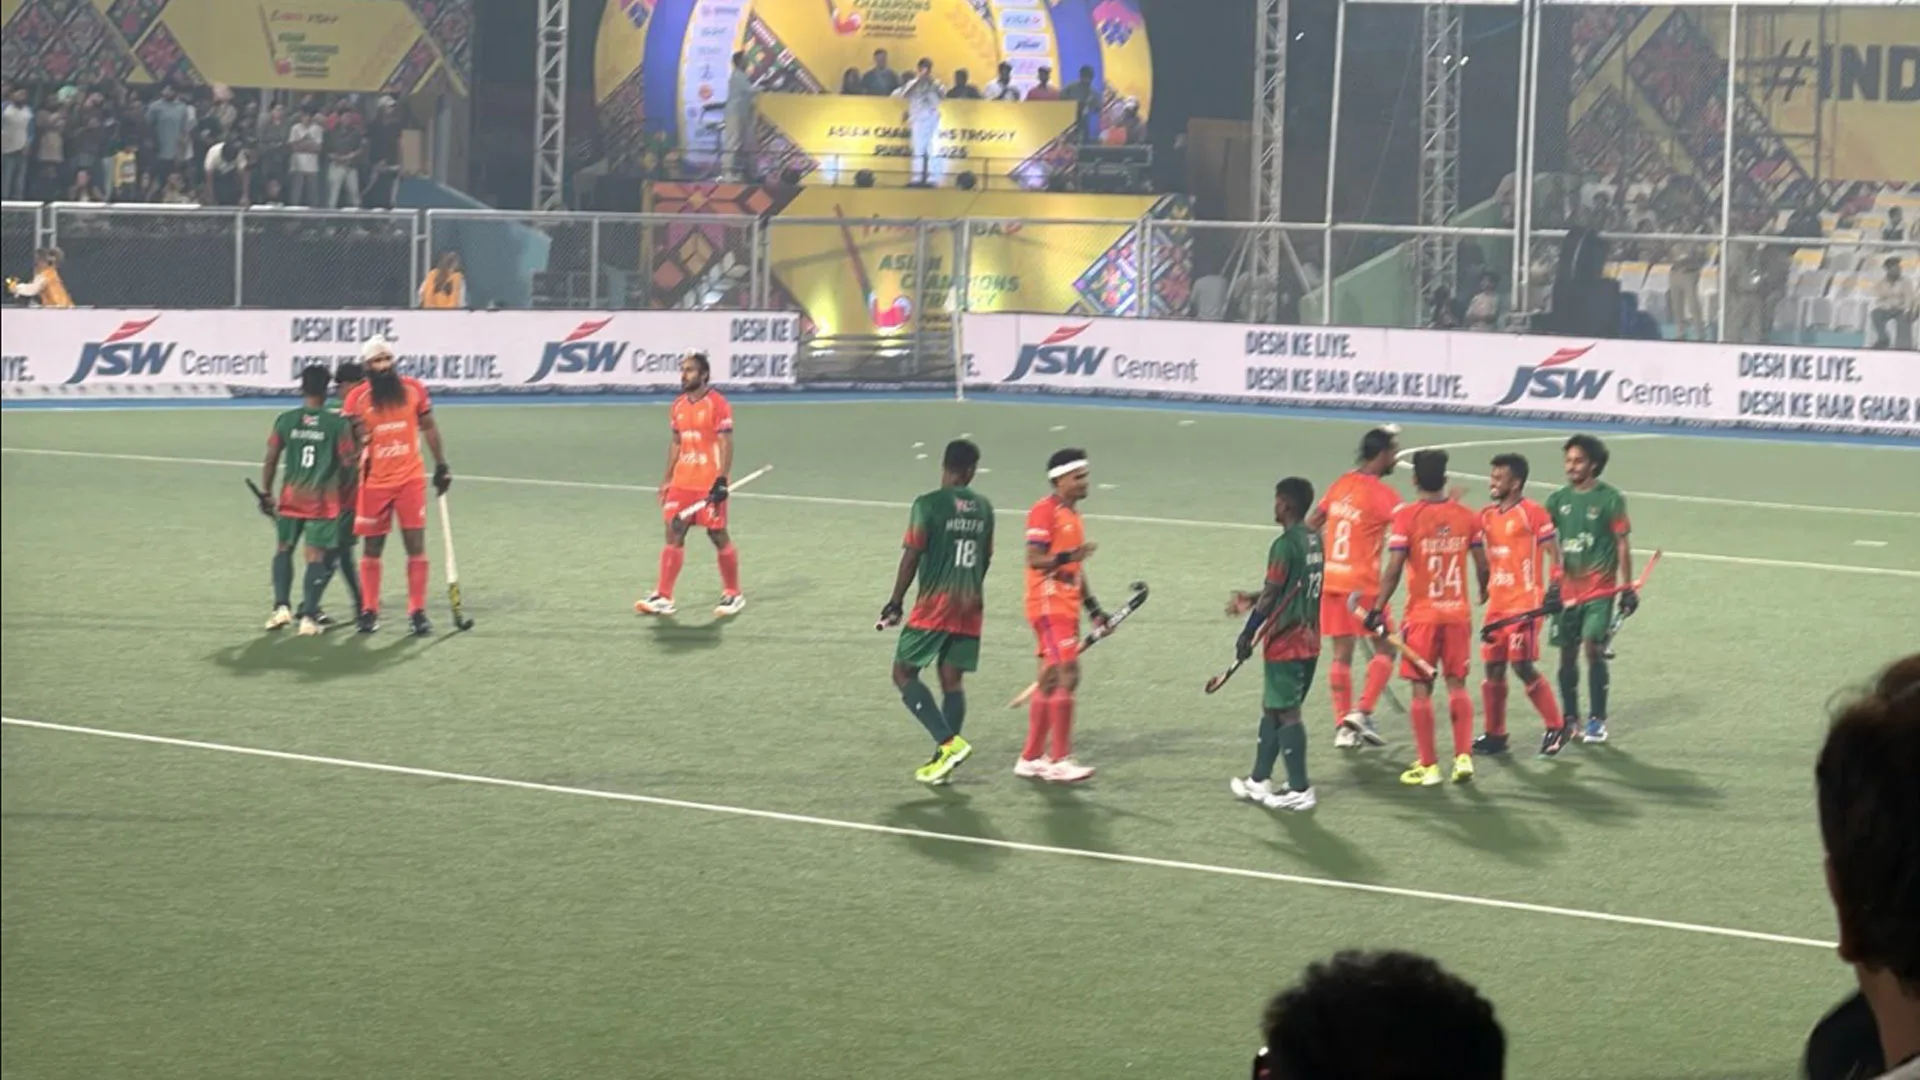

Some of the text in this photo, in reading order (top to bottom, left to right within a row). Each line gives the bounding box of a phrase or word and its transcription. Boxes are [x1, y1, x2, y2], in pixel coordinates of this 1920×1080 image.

[291, 318, 332, 342] DESH
[336, 318, 357, 342] KE
[731, 318, 768, 342] DESH
[771, 318, 791, 342] KE
[1246, 331, 1356, 359] DESH KE LIYE.
[62, 342, 177, 384] JSW
[180, 349, 268, 375] Cement
[441, 355, 462, 380] KE
[464, 356, 502, 381] LIYE.
[524, 342, 630, 384] JSW
[731, 354, 790, 378] DESH KE
[1002, 343, 1199, 382] JSW Cement
[1739, 352, 1862, 382] DESH KE LIYE.
[1246, 366, 1468, 399] DESH KE HAR GHAR KE LIYE.
[1495, 366, 1714, 408] JSW Cement
[1739, 390, 1911, 422] DESH KE HAR GHAR
[301, 445, 315, 468] 6
[954, 538, 977, 568] 18
[1331, 519, 1353, 561] 8
